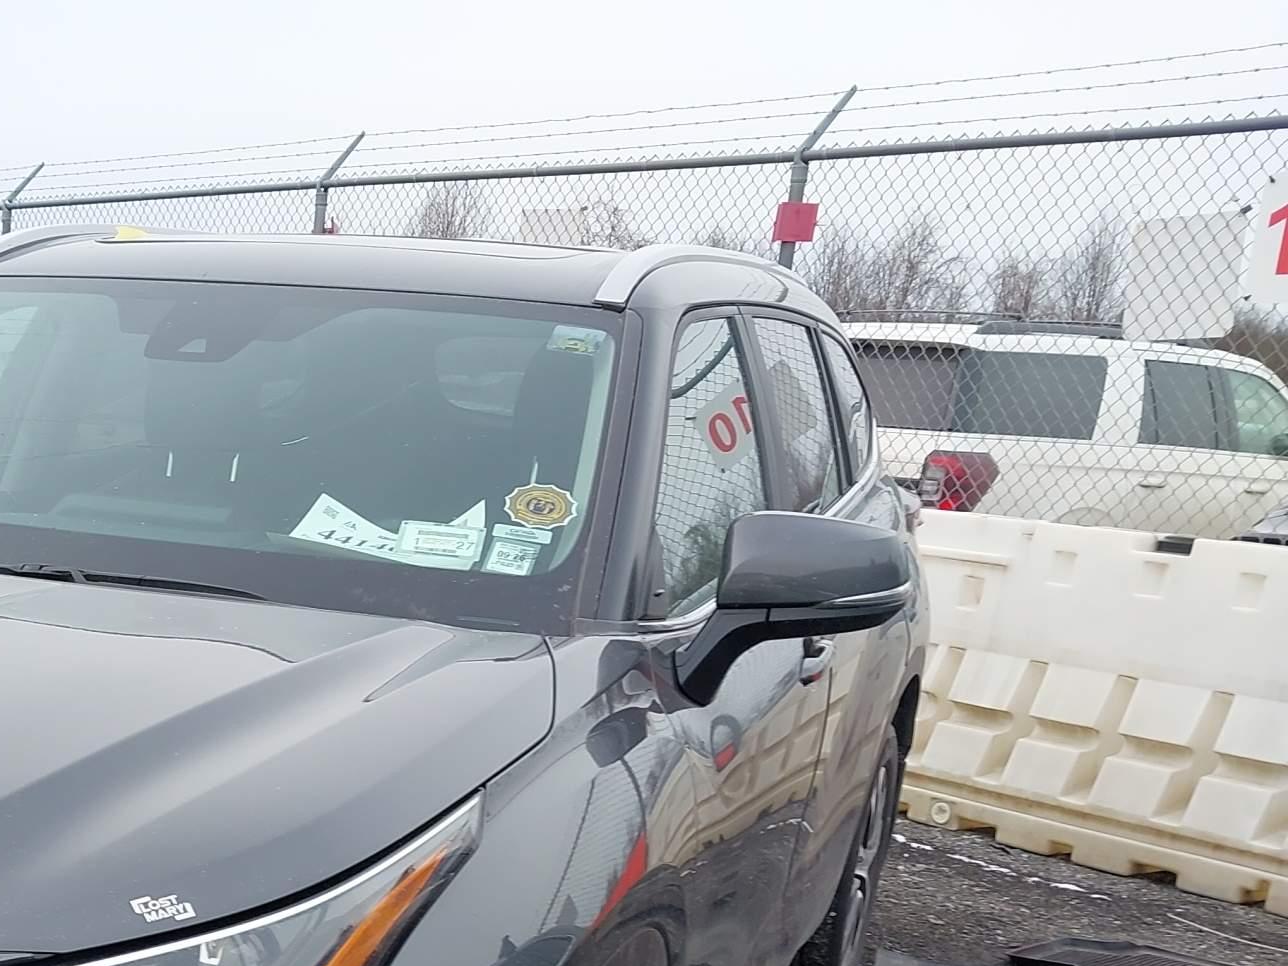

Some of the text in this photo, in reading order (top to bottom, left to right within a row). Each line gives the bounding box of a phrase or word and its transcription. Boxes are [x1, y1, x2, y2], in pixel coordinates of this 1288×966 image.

[455, 541, 475, 551] 27
[139, 894, 178, 913] LOST
[143, 902, 187, 923] MARY
